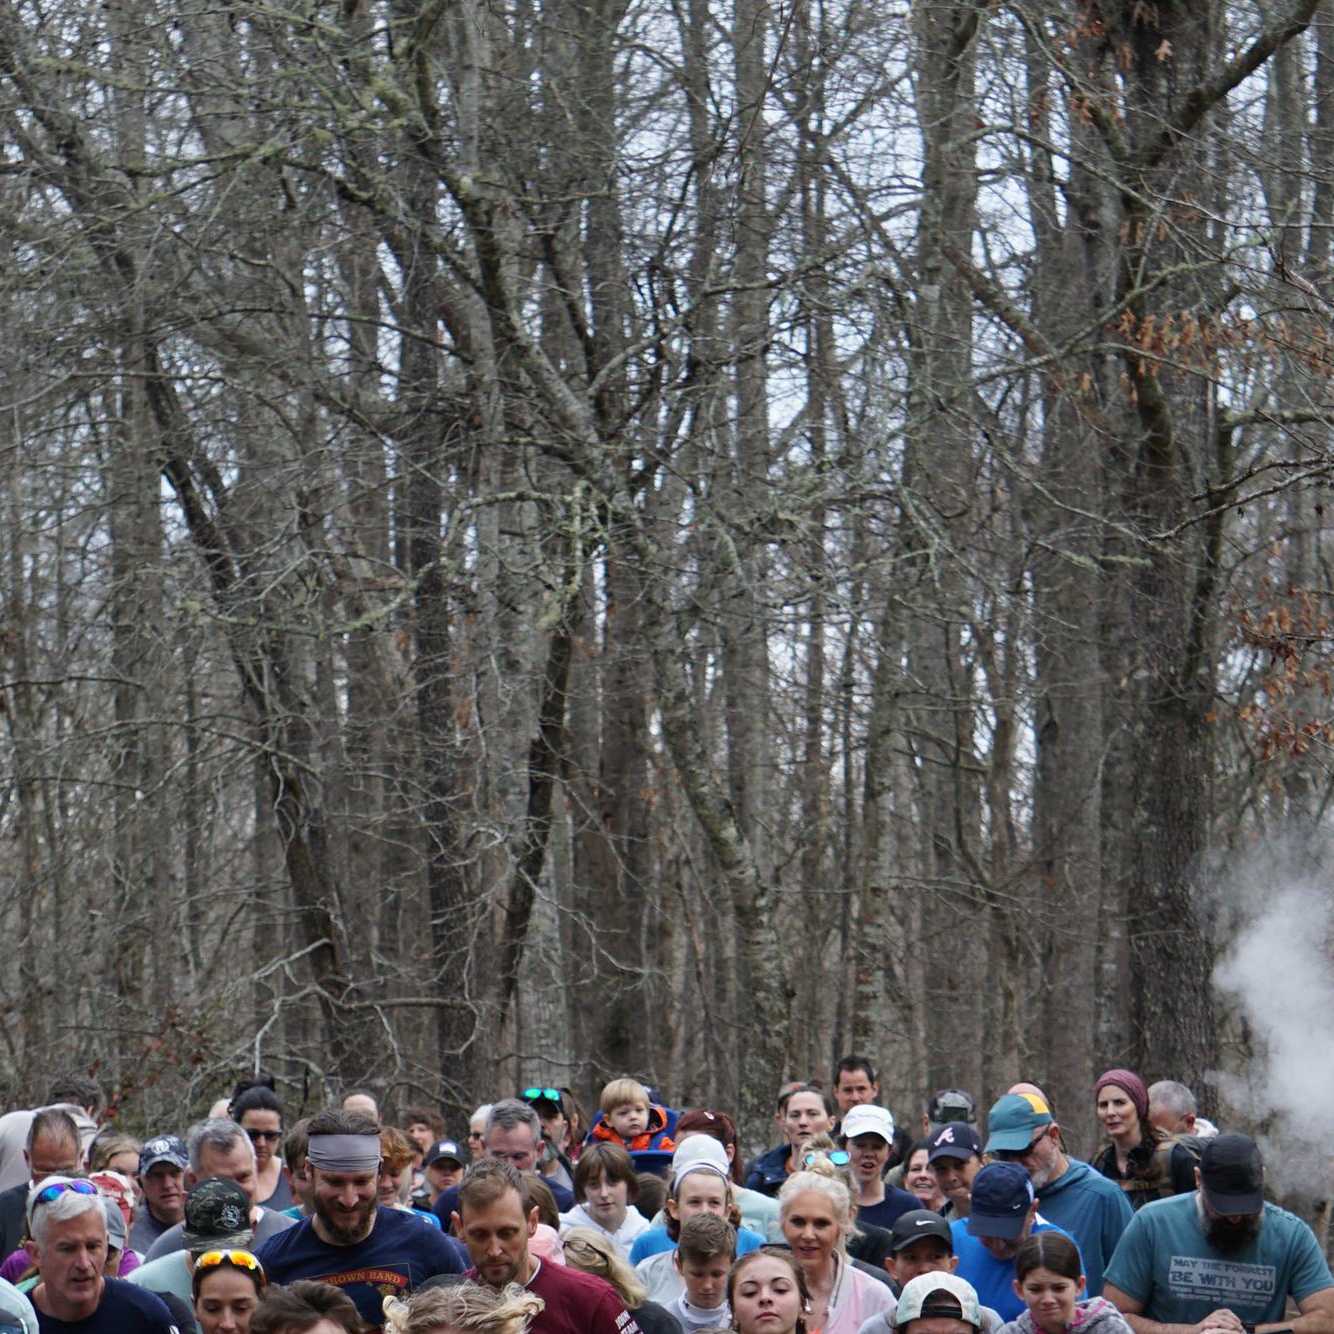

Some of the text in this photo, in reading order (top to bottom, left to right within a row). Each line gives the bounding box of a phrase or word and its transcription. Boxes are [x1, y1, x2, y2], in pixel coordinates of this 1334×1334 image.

[1173, 1259, 1197, 1268] MAY
[1201, 1261, 1222, 1271] THE
[323, 1272, 401, 1286] ROWN BAND
[1171, 1271, 1274, 1291] BE WITH YOU
[615, 1310, 631, 1330] JOIN
